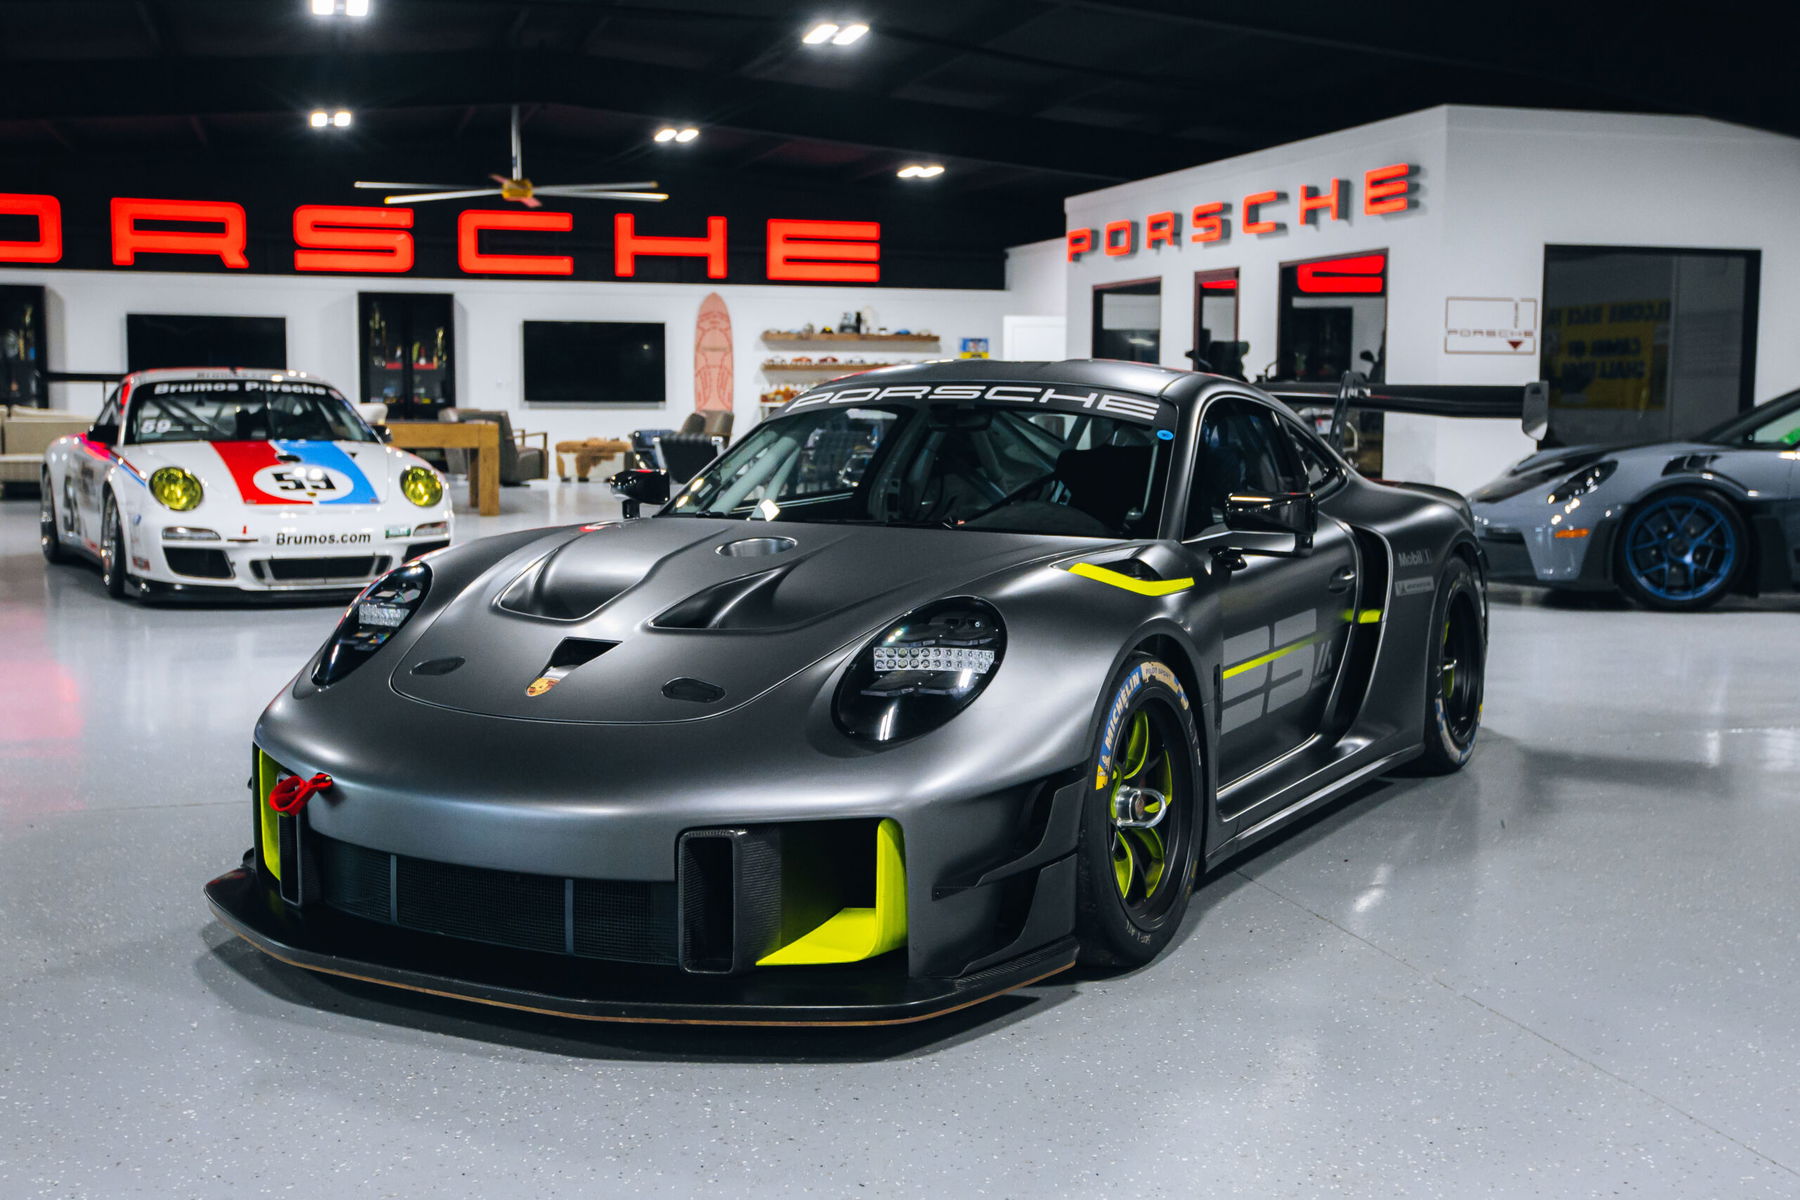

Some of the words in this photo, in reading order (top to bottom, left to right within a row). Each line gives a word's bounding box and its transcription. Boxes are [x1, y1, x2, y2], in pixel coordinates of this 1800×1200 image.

[1067, 163, 1410, 263] PORSCHE
[154, 382, 239, 395] Brumos
[245, 381, 327, 396] Porsche
[785, 385, 1160, 421] PORSCHE
[141, 418, 172, 434] 59
[272, 471, 336, 491] 59
[276, 532, 371, 546] Brumos.com
[1398, 550, 1423, 568] Mobil
[1105, 671, 1140, 751] MICHELIN
